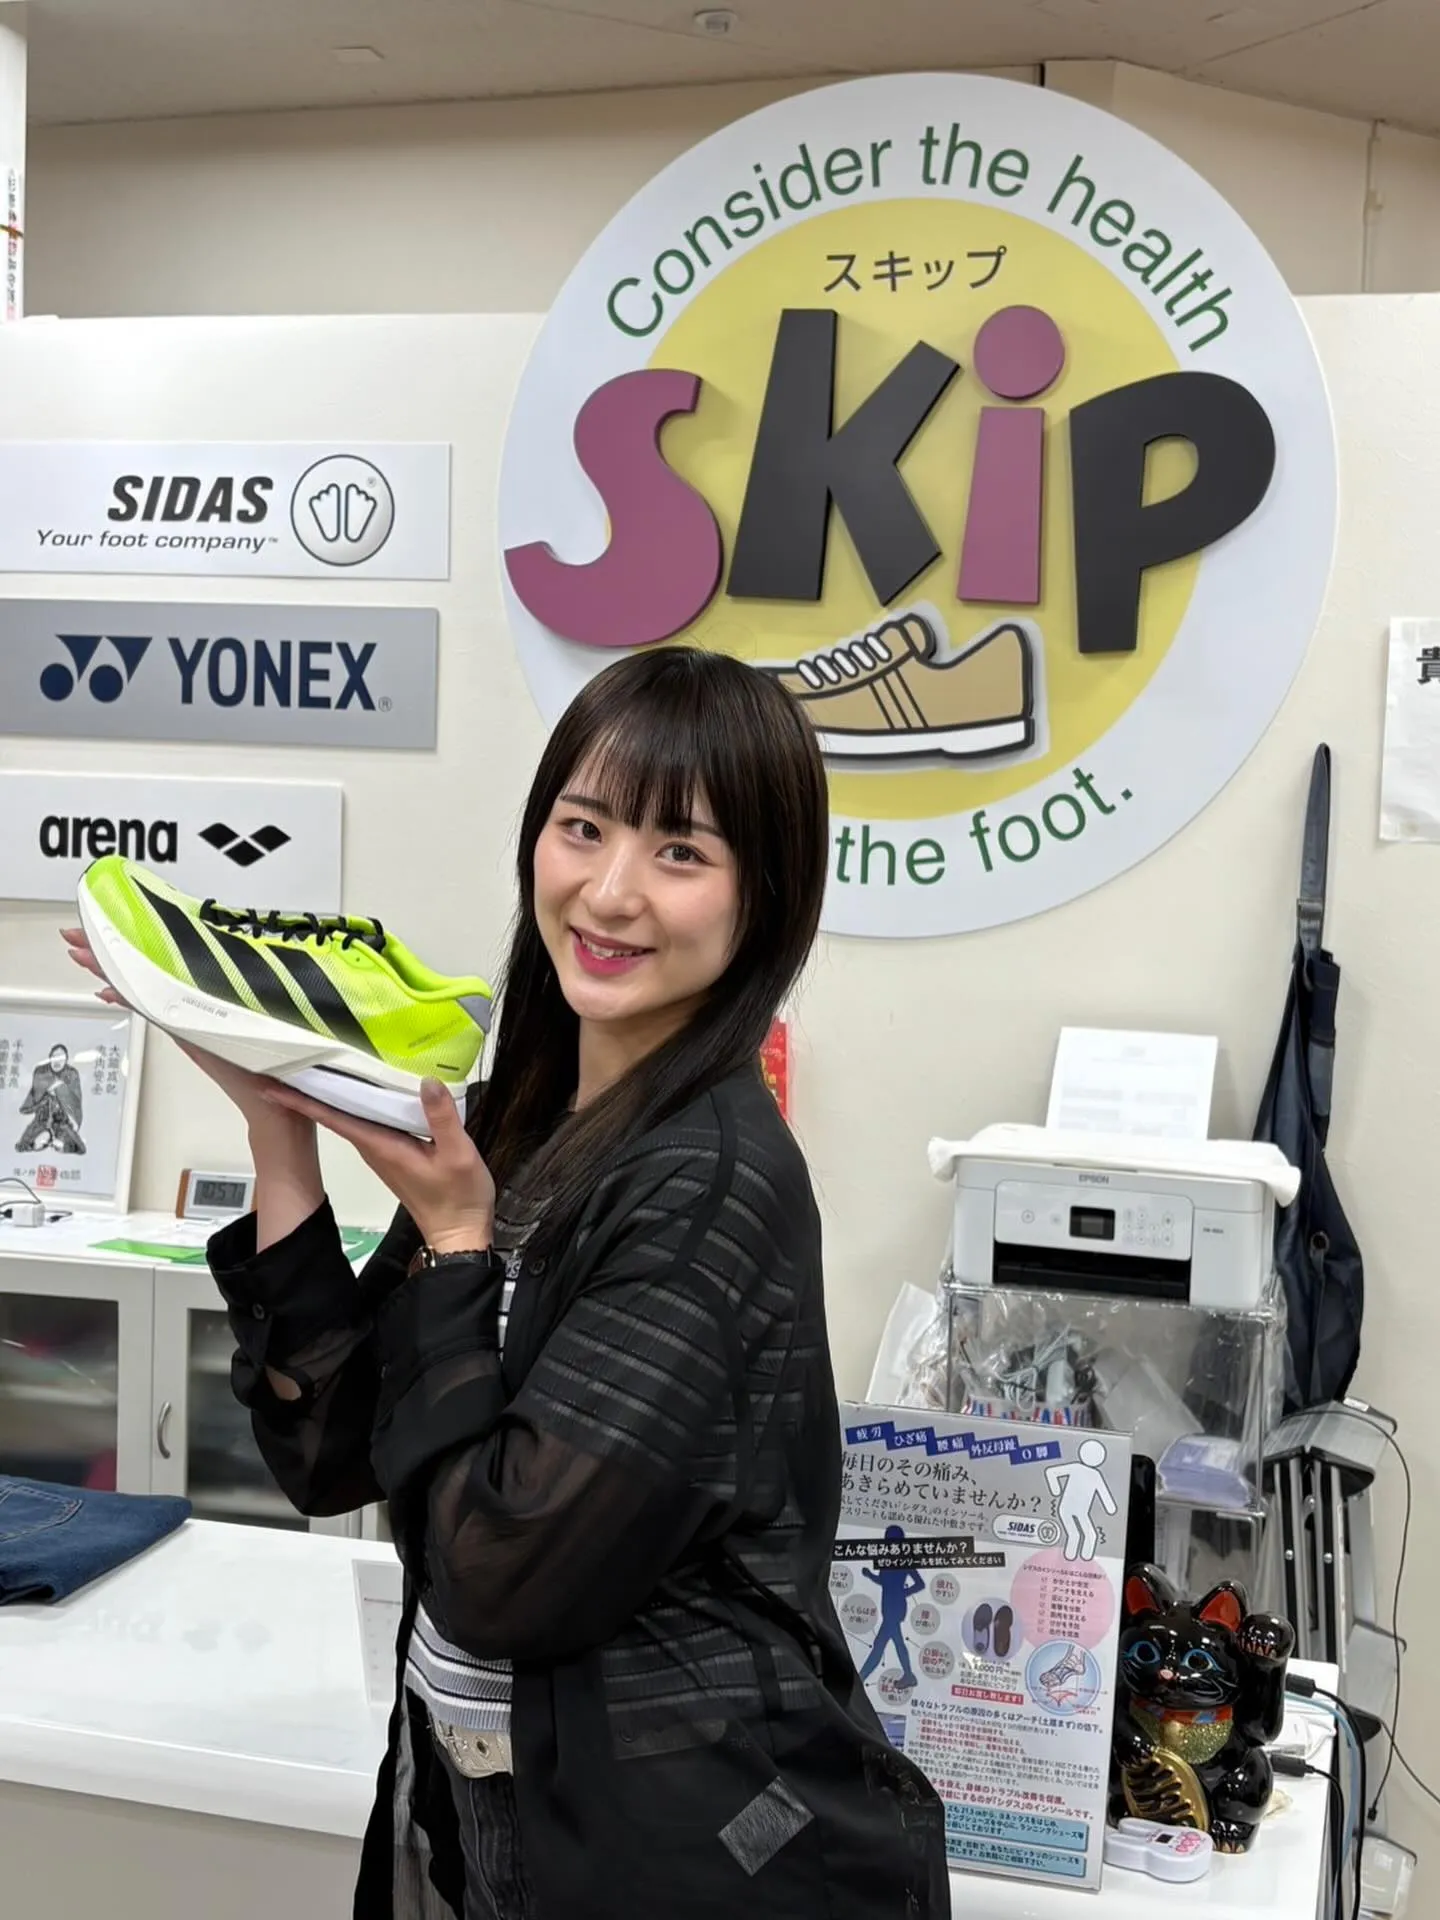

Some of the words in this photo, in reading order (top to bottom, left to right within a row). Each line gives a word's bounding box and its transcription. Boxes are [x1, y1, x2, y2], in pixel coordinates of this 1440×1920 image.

[606, 137, 893, 338] Consider
[918, 123, 1029, 199] the
[1047, 154, 1231, 353] health
[823, 245, 1007, 293] スキップ
[107, 475, 274, 524] SIDAS
[37, 529, 92, 548] Your
[99, 531, 148, 550] foot
[39, 815, 178, 863] arena
[835, 824, 946, 886] the
[969, 767, 1134, 873] foot.
[894, 1431, 928, 1446] ひざ痛
[971, 1436, 1017, 1456] 外反母趾
[1006, 1521, 1036, 1534] SIDAS
